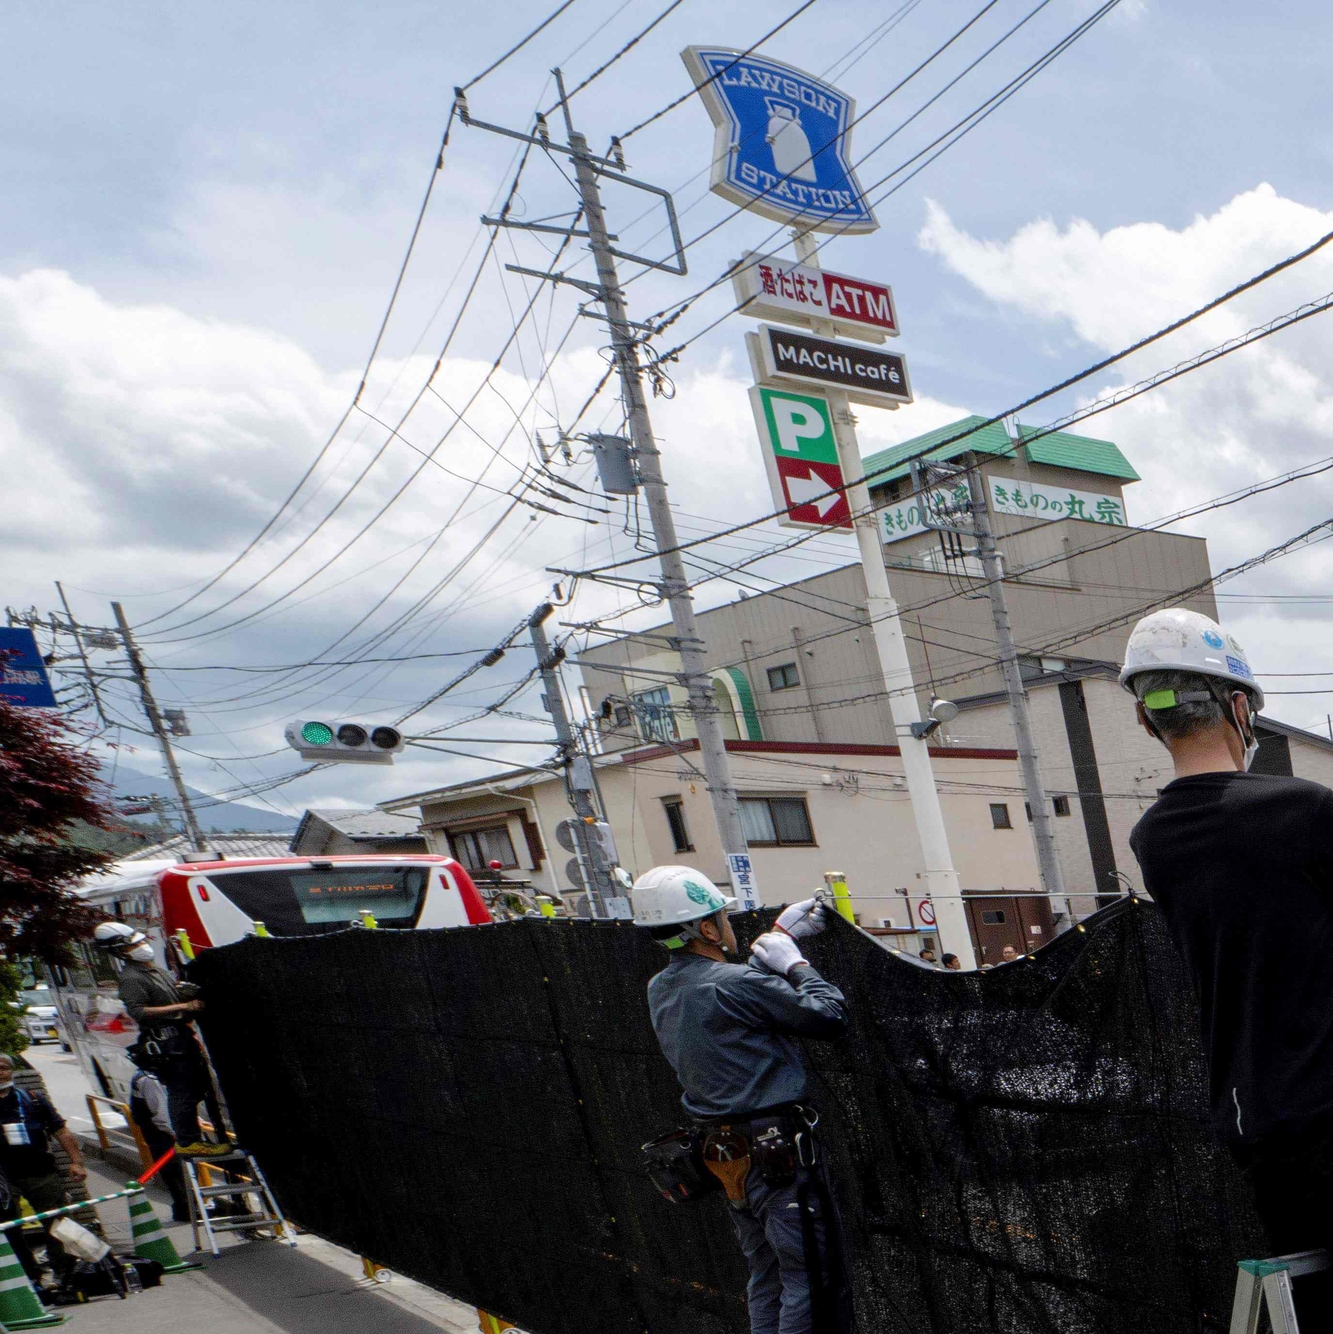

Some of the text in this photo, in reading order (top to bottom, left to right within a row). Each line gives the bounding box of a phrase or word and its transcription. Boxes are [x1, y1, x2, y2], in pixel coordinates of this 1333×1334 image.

[716, 64, 838, 120] LAWSON
[740, 161, 857, 210] STATION
[830, 282, 892, 322] ATM
[776, 343, 901, 384] MACHI café
[769, 396, 826, 452] P
[993, 484, 1125, 526] きものの丸宗
